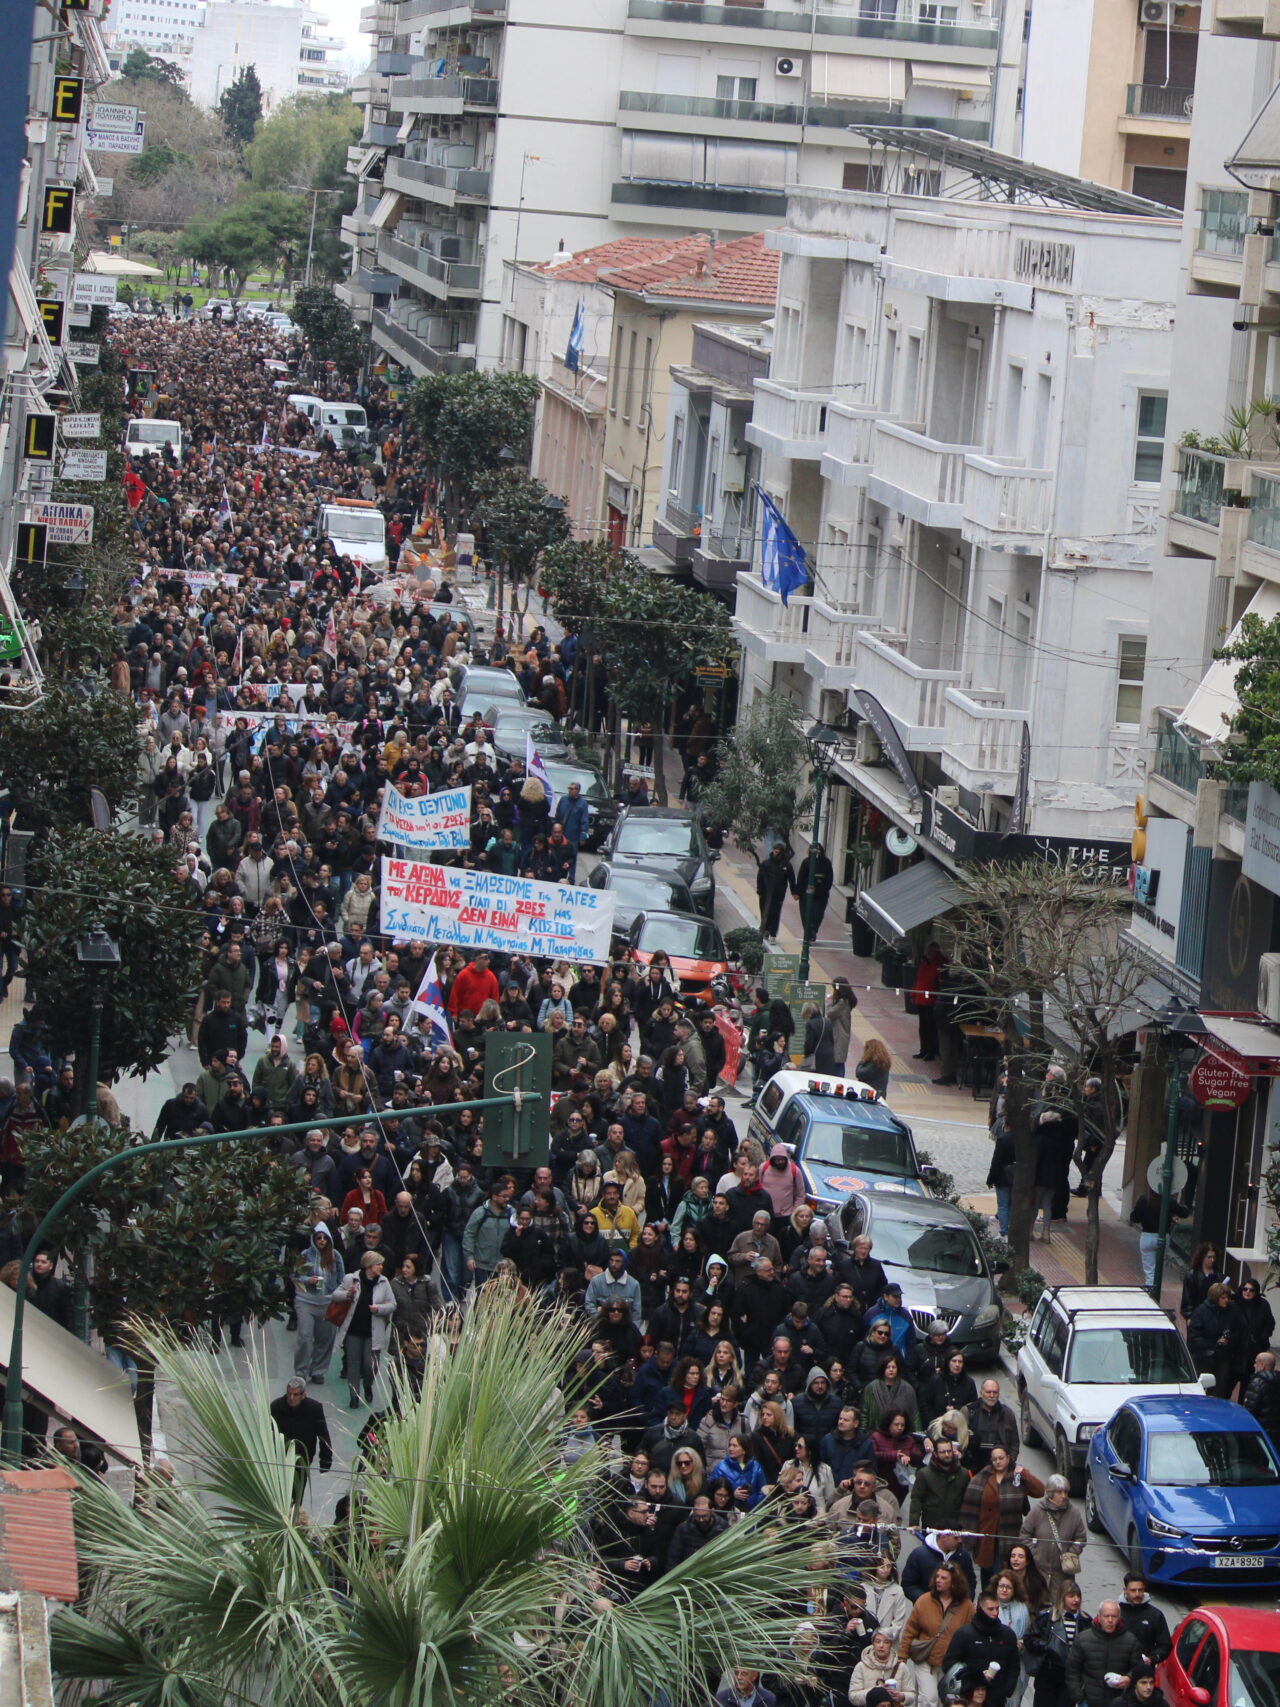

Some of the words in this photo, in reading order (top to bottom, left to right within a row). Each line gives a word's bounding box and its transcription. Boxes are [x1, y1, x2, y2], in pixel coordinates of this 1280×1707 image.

[42, 505, 83, 519] ΑΓΓΛΙΚΑ
[58, 518, 87, 528] ΠΑΠΠΑΣ
[1068, 846, 1110, 862] THE
[388, 859, 409, 879] ΜΕ
[408, 864, 446, 888] ΑΓΩΝΑ
[464, 871, 533, 899] ΞΗΛΩΣΟΥΜΕ
[558, 888, 597, 909] ΡΑΓΕΣ
[404, 884, 463, 909] ΚΕΡΔΟΥΣ
[468, 894, 490, 909] ΓΙΑΤΙ
[515, 900, 546, 917] ΖΩΕΣ
[457, 906, 488, 924] ΔΕΝ
[490, 910, 520, 929] ΕΙΝΑΙ
[528, 917, 576, 938] ΚΟΣΤΟΣ
[1197, 1067, 1229, 1077] Gluten
[1198, 1076, 1228, 1087] Sugar
[1230, 1078, 1249, 1088] free
[1206, 1087, 1236, 1098] Vegan
